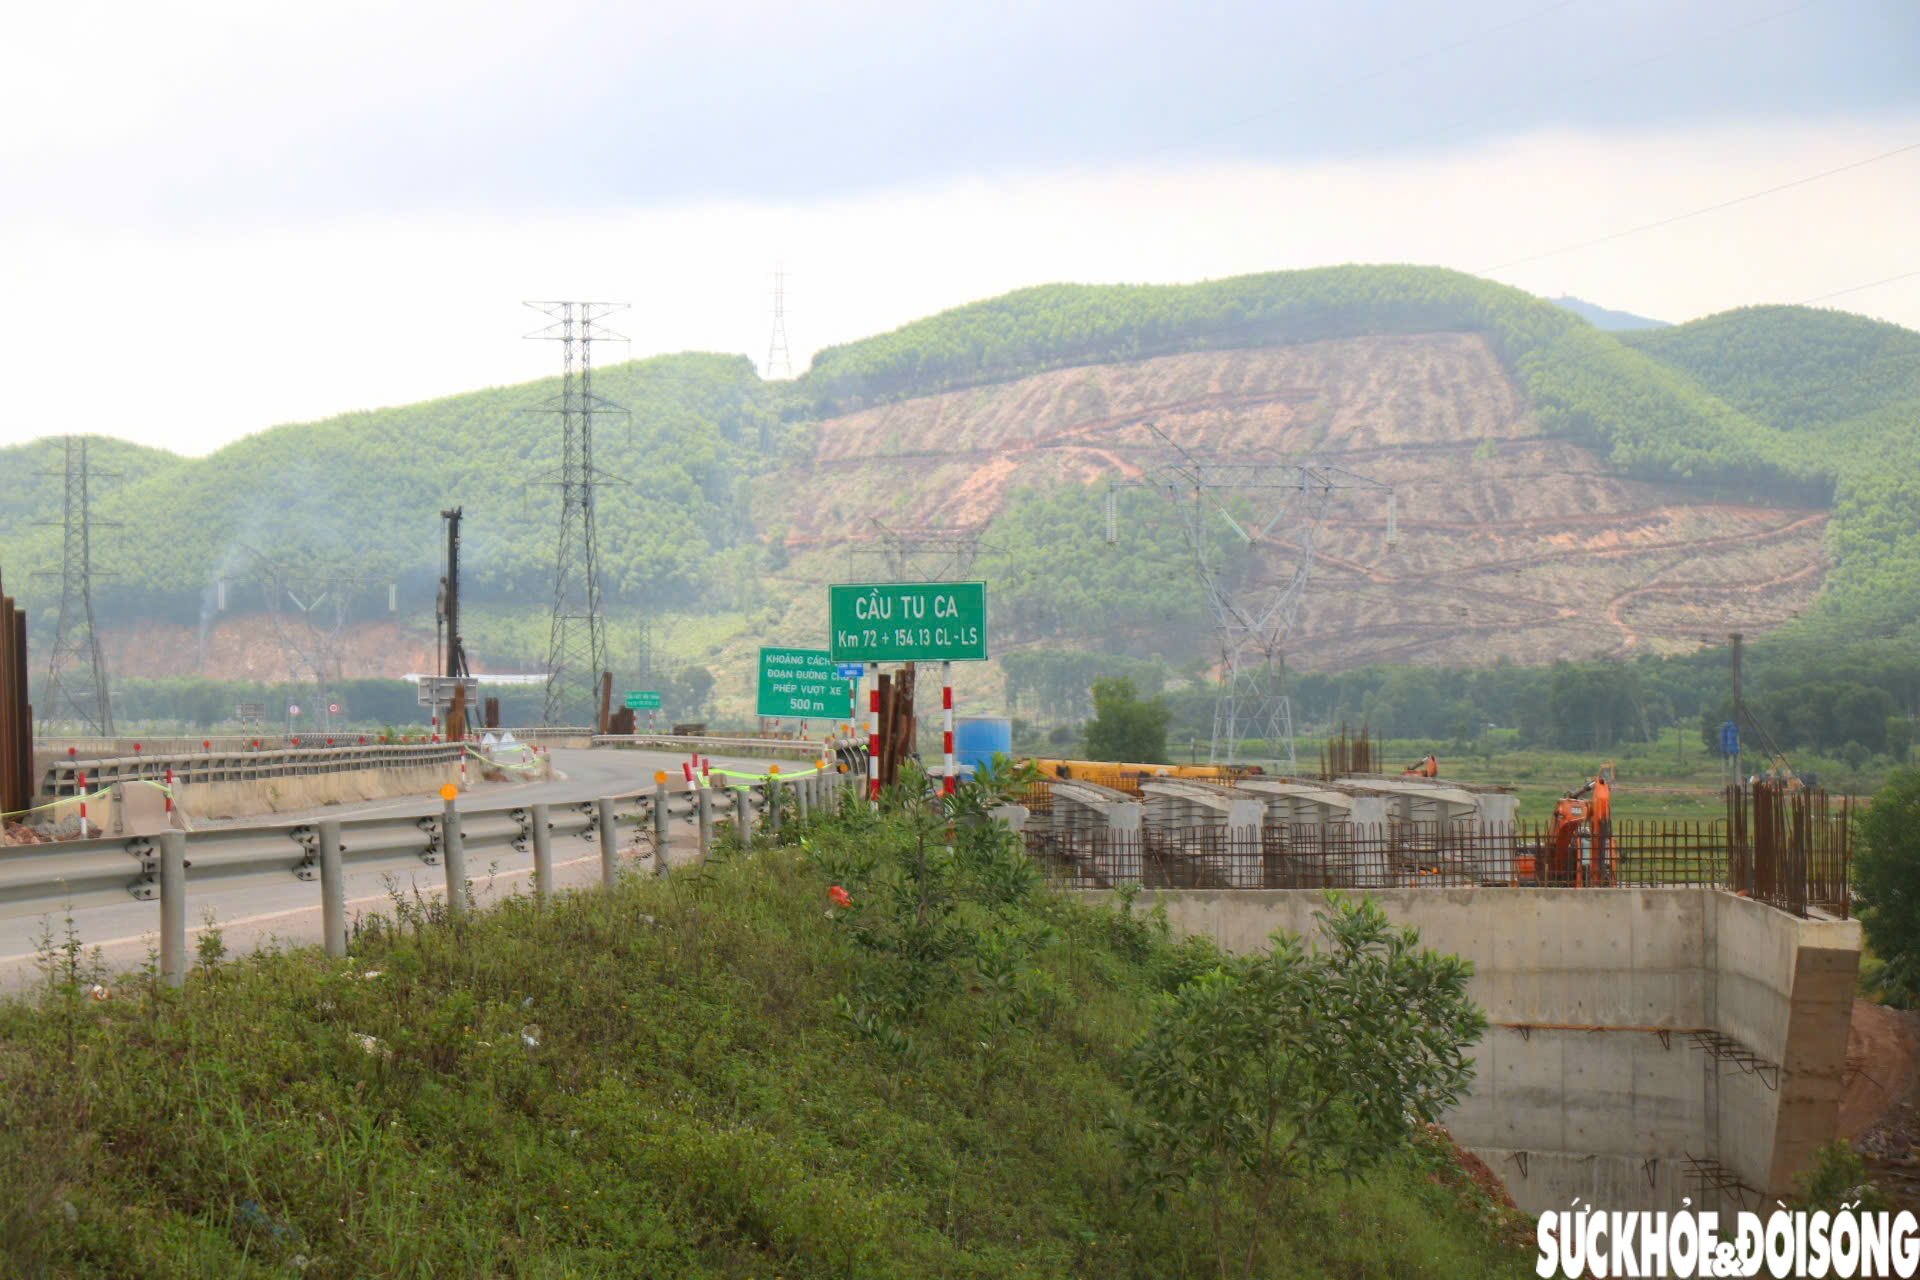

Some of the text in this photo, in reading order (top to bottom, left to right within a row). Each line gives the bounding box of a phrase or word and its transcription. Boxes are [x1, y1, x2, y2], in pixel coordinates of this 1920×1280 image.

[855, 588, 959, 620] CẦU TU CA
[838, 630, 858, 647] Km
[863, 630, 877, 647] 72
[882, 633, 889, 645] +
[895, 628, 930, 646] 154.13
[790, 698, 824, 711] 500 m
